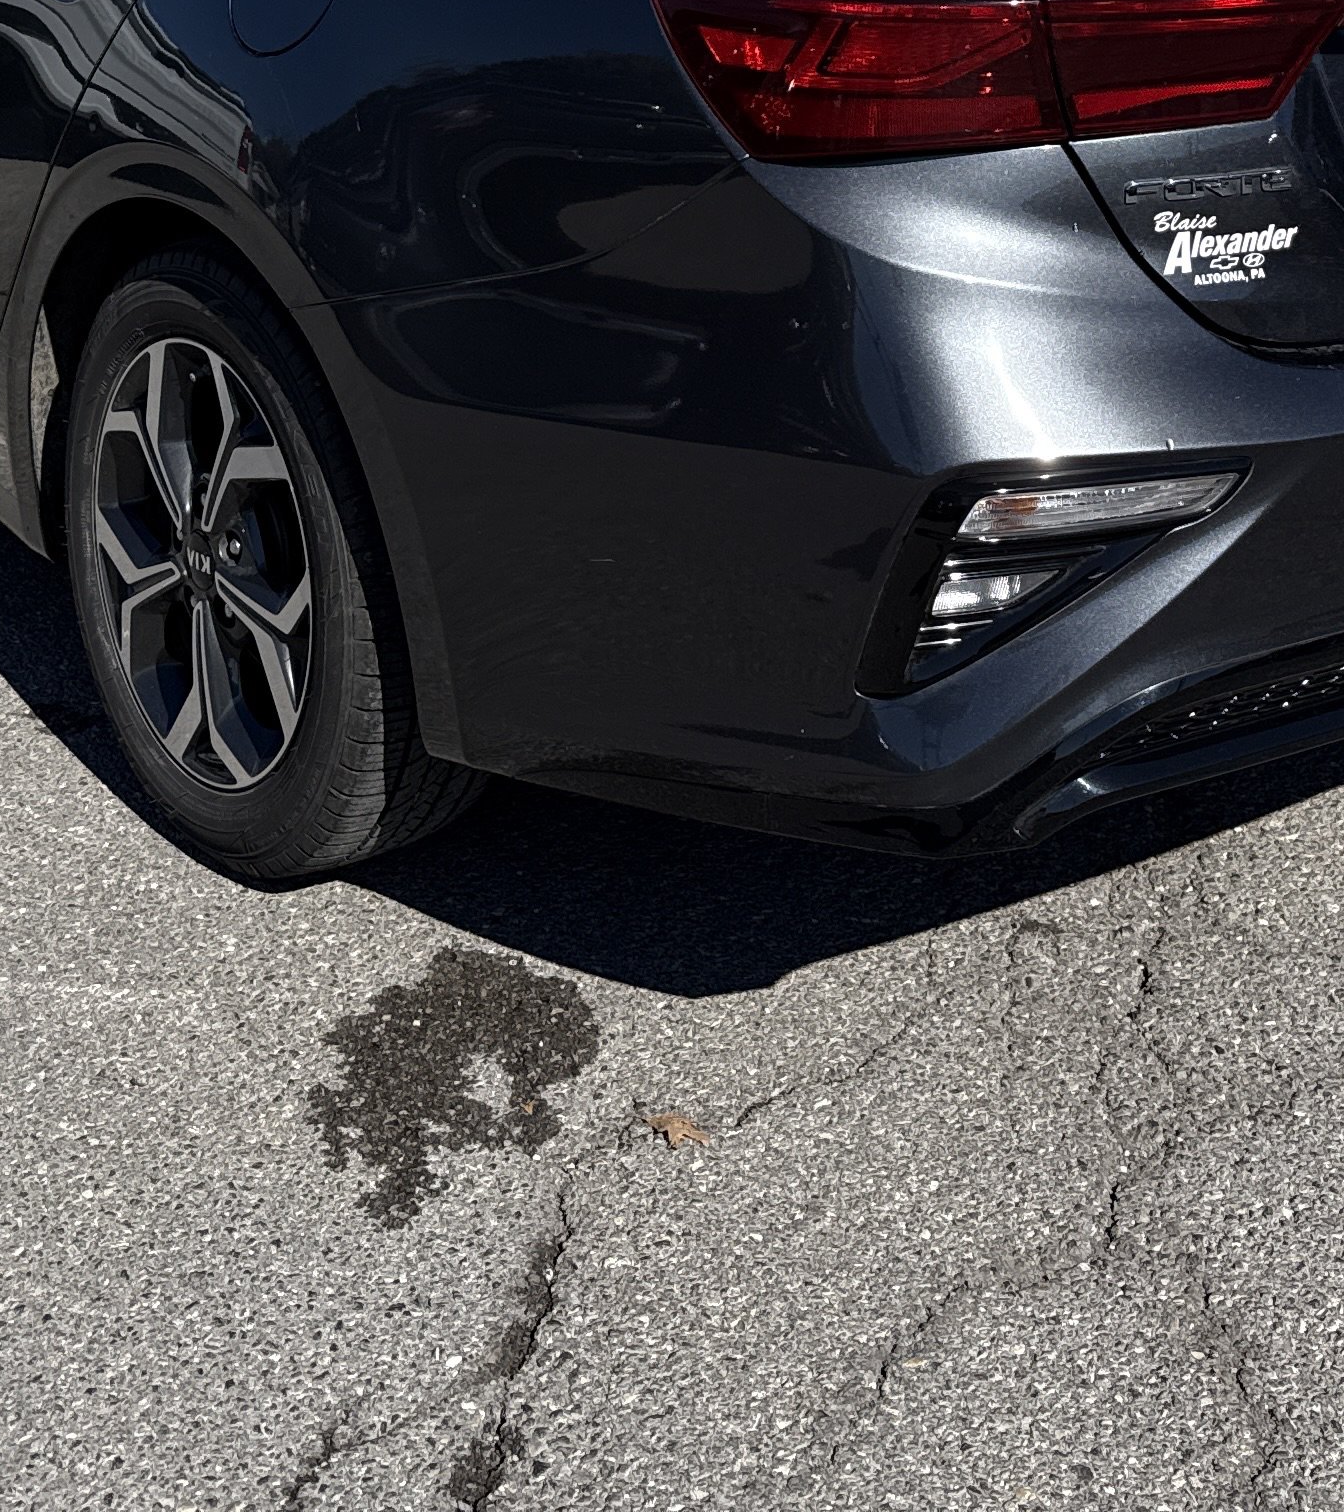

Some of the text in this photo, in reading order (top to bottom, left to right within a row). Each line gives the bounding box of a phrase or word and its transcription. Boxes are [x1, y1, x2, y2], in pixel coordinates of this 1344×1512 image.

[1123, 165, 1296, 205] FORTE
[1153, 210, 1218, 233] Blaise
[1163, 223, 1300, 276] Alexander
[1194, 267, 1266, 287] ALTOONA, PA
[187, 546, 211, 575] KIA
